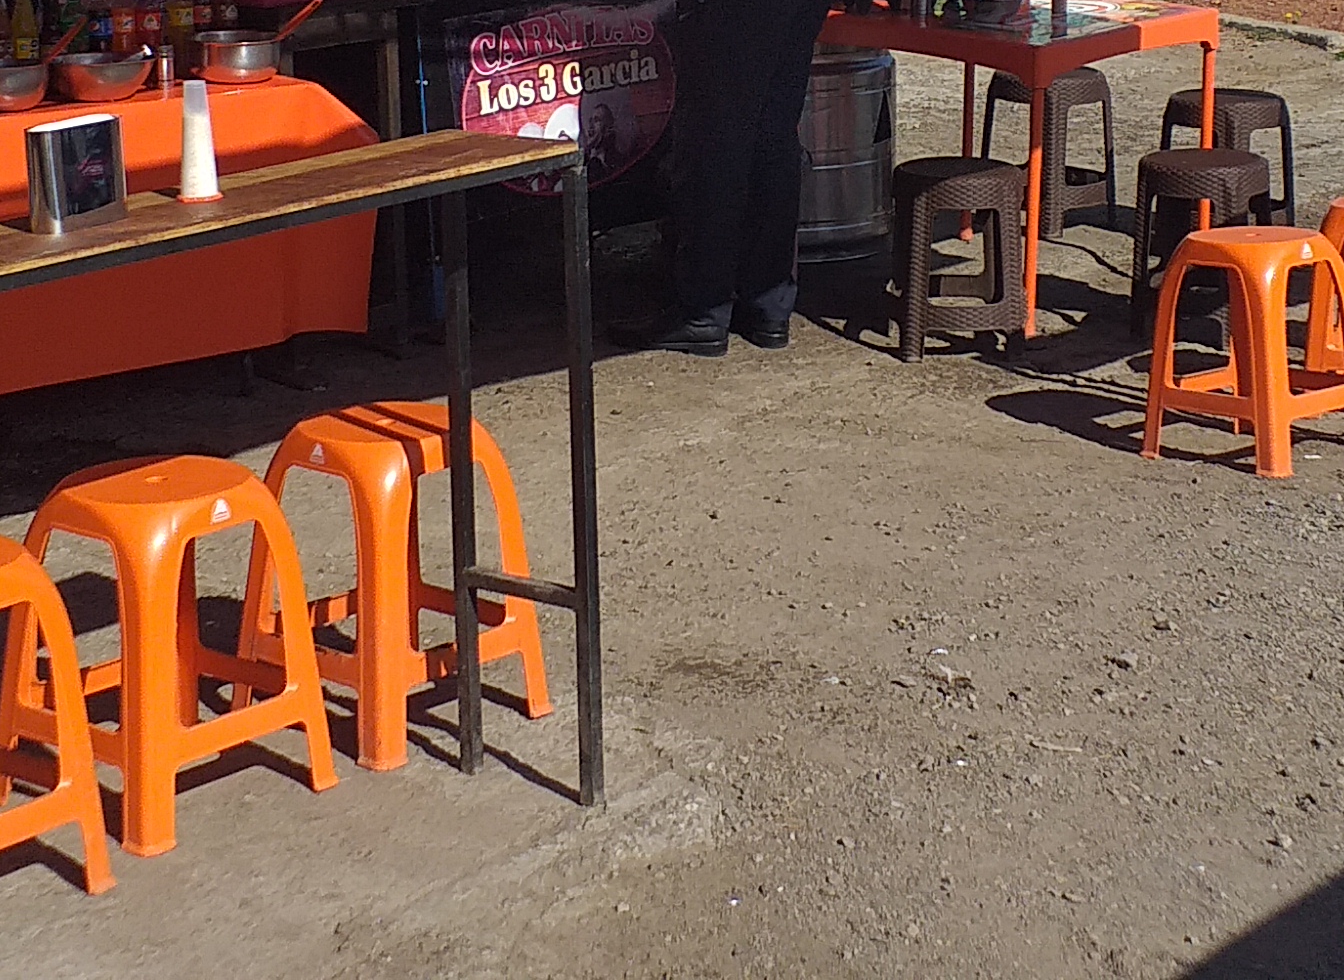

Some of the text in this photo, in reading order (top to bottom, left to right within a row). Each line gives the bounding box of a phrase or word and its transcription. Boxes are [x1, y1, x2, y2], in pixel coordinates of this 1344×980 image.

[470, 5, 655, 76] CARNITAS
[477, 49, 659, 115] Los 3 Garcia
